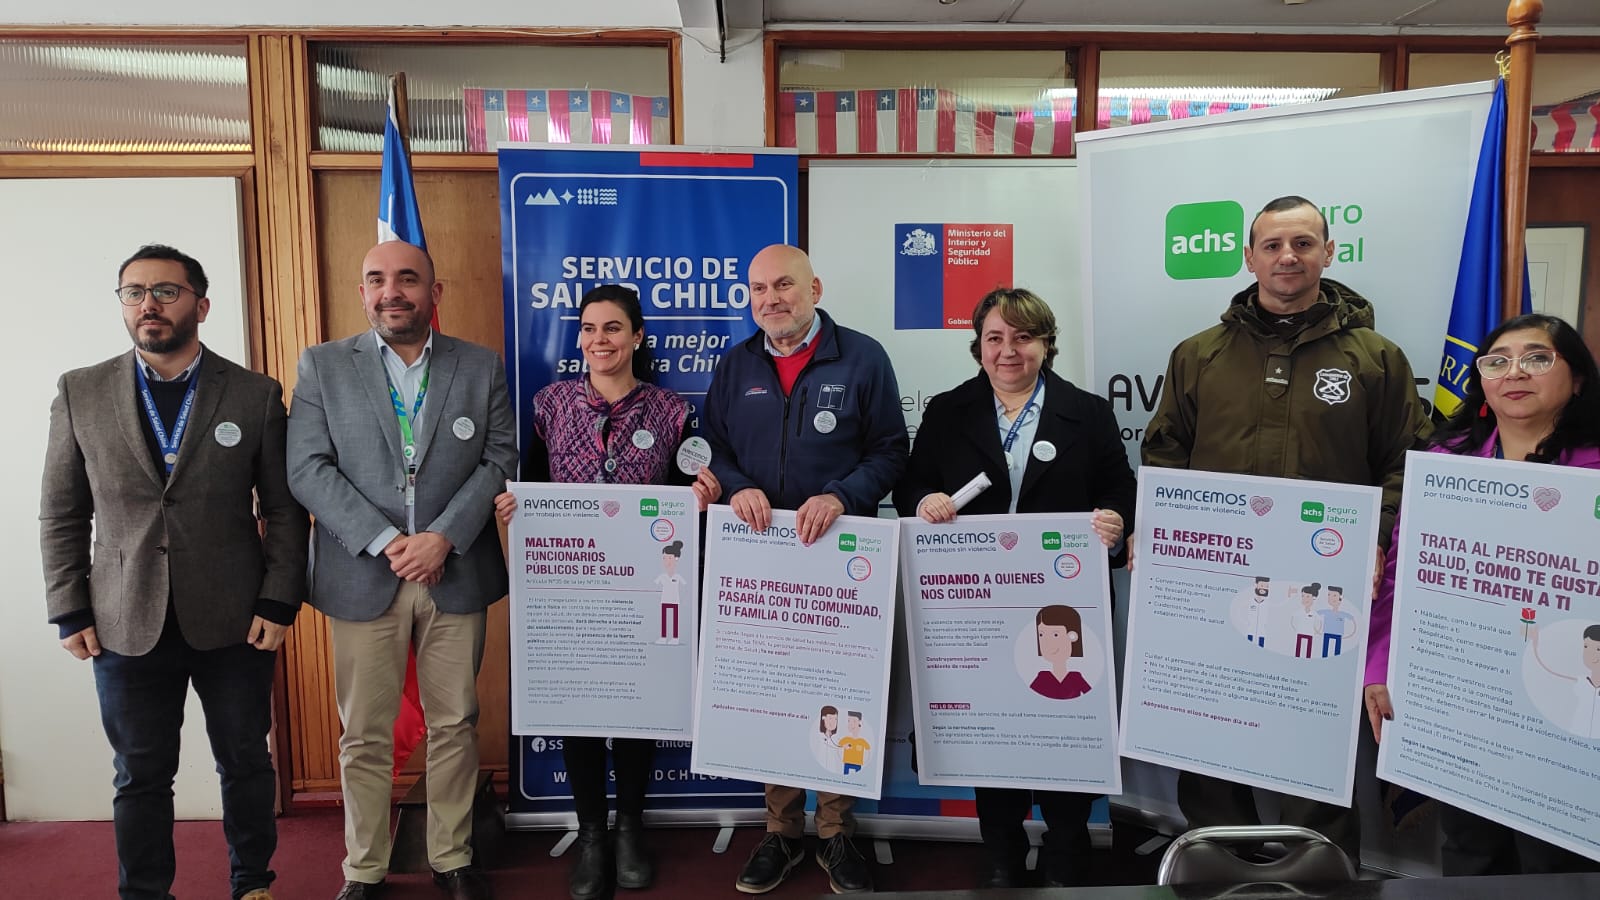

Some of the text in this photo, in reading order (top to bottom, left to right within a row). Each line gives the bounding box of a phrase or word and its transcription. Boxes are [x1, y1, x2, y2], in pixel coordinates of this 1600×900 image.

[1172, 229, 1235, 254] achs
[948, 248, 991, 257] Seguridad
[948, 257, 979, 265] Pública
[562, 256, 738, 280] SERVICIO DE
[652, 283, 750, 309] CHILO
[664, 330, 730, 352] mejor
[1425, 474, 1530, 499] AVANCEMOS
[524, 499, 599, 510] AVANCEMOS
[1156, 486, 1247, 506] AVANCEMOS
[1439, 492, 1473, 503] trabajos
[1489, 499, 1527, 510] violencia
[1168, 502, 1198, 511] trabajos
[1212, 506, 1245, 515] violencia
[1303, 507, 1322, 517] achs
[1328, 506, 1357, 515] seguro
[1327, 514, 1357, 525] laboral
[525, 538, 595, 548] MALTRATO A
[916, 532, 996, 545] AVANCEMOS
[1153, 528, 1253, 550] EL RESPETO ES
[526, 551, 605, 562] FUNCIONARIOS
[1152, 543, 1250, 566] FUNDAMENTAL
[1421, 532, 1600, 576] TRATA AL PERSONAL D
[526, 562, 634, 576] PÚBLICOS DE SALUD
[1418, 551, 1469, 574] SALUD,
[1475, 560, 1521, 581] COMO
[1527, 570, 1546, 586] TE
[720, 576, 858, 600] TE HAS PREGUNTADO QUÉ
[920, 573, 1045, 586] CUIDANDO A QUIENES
[921, 588, 991, 600] NOS CUIDAN
[1418, 568, 1571, 611] QUE TE TRATEN A TI
[719, 591, 881, 620] PASARÍA CON TU COMUNIDAD,
[718, 604, 849, 629] TU FAMILIA O CONTIGO...
[1451, 618, 1469, 626] como
[1478, 623, 1497, 633] gusta
[1499, 627, 1511, 636] que
[1425, 640, 1452, 651] respeten
[1456, 638, 1474, 646] como
[1476, 641, 1502, 652] esperas
[1448, 654, 1466, 664] como
[1474, 662, 1498, 673] apoyan
[1409, 662, 1512, 696] Para mantener nuestros centros
[1417, 673, 1434, 684] salud
[1435, 678, 1462, 691] abiertos
[1475, 691, 1513, 706] comunidad
[1405, 699, 1422, 709] redes
[1466, 706, 1487, 719] cerrar
[1496, 715, 1518, 729] puerta
[1534, 726, 1567, 742] violencia
[1527, 714, 1543, 725] para
[1537, 754, 1577, 774] enfrentados
